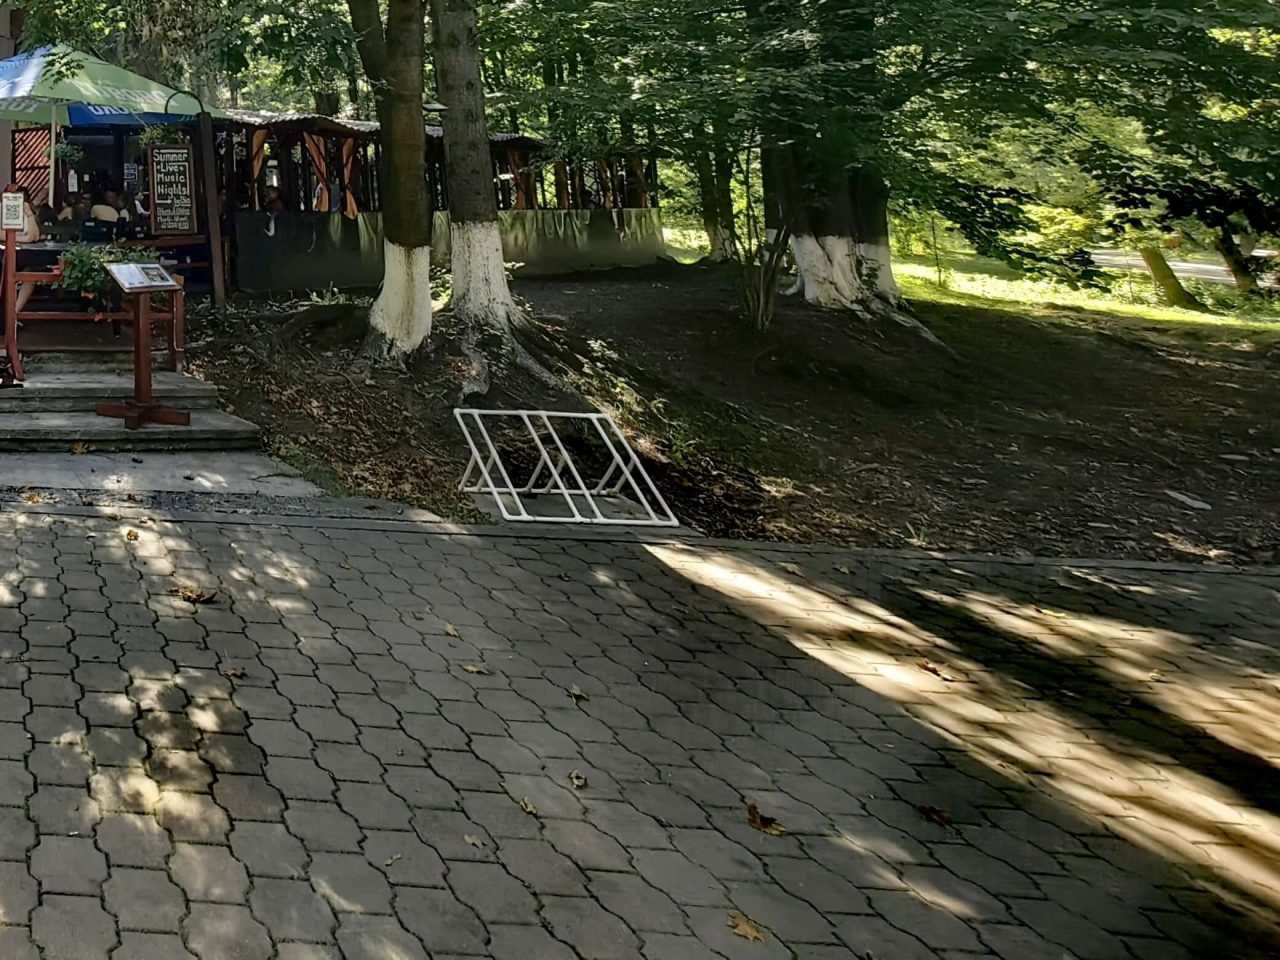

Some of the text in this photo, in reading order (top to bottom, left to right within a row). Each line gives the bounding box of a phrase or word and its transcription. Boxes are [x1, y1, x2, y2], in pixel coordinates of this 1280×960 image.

[153, 149, 188, 161] Summer
[160, 162, 179, 172] Live
[157, 173, 186, 182] Music
[157, 183, 187, 198] Nights
